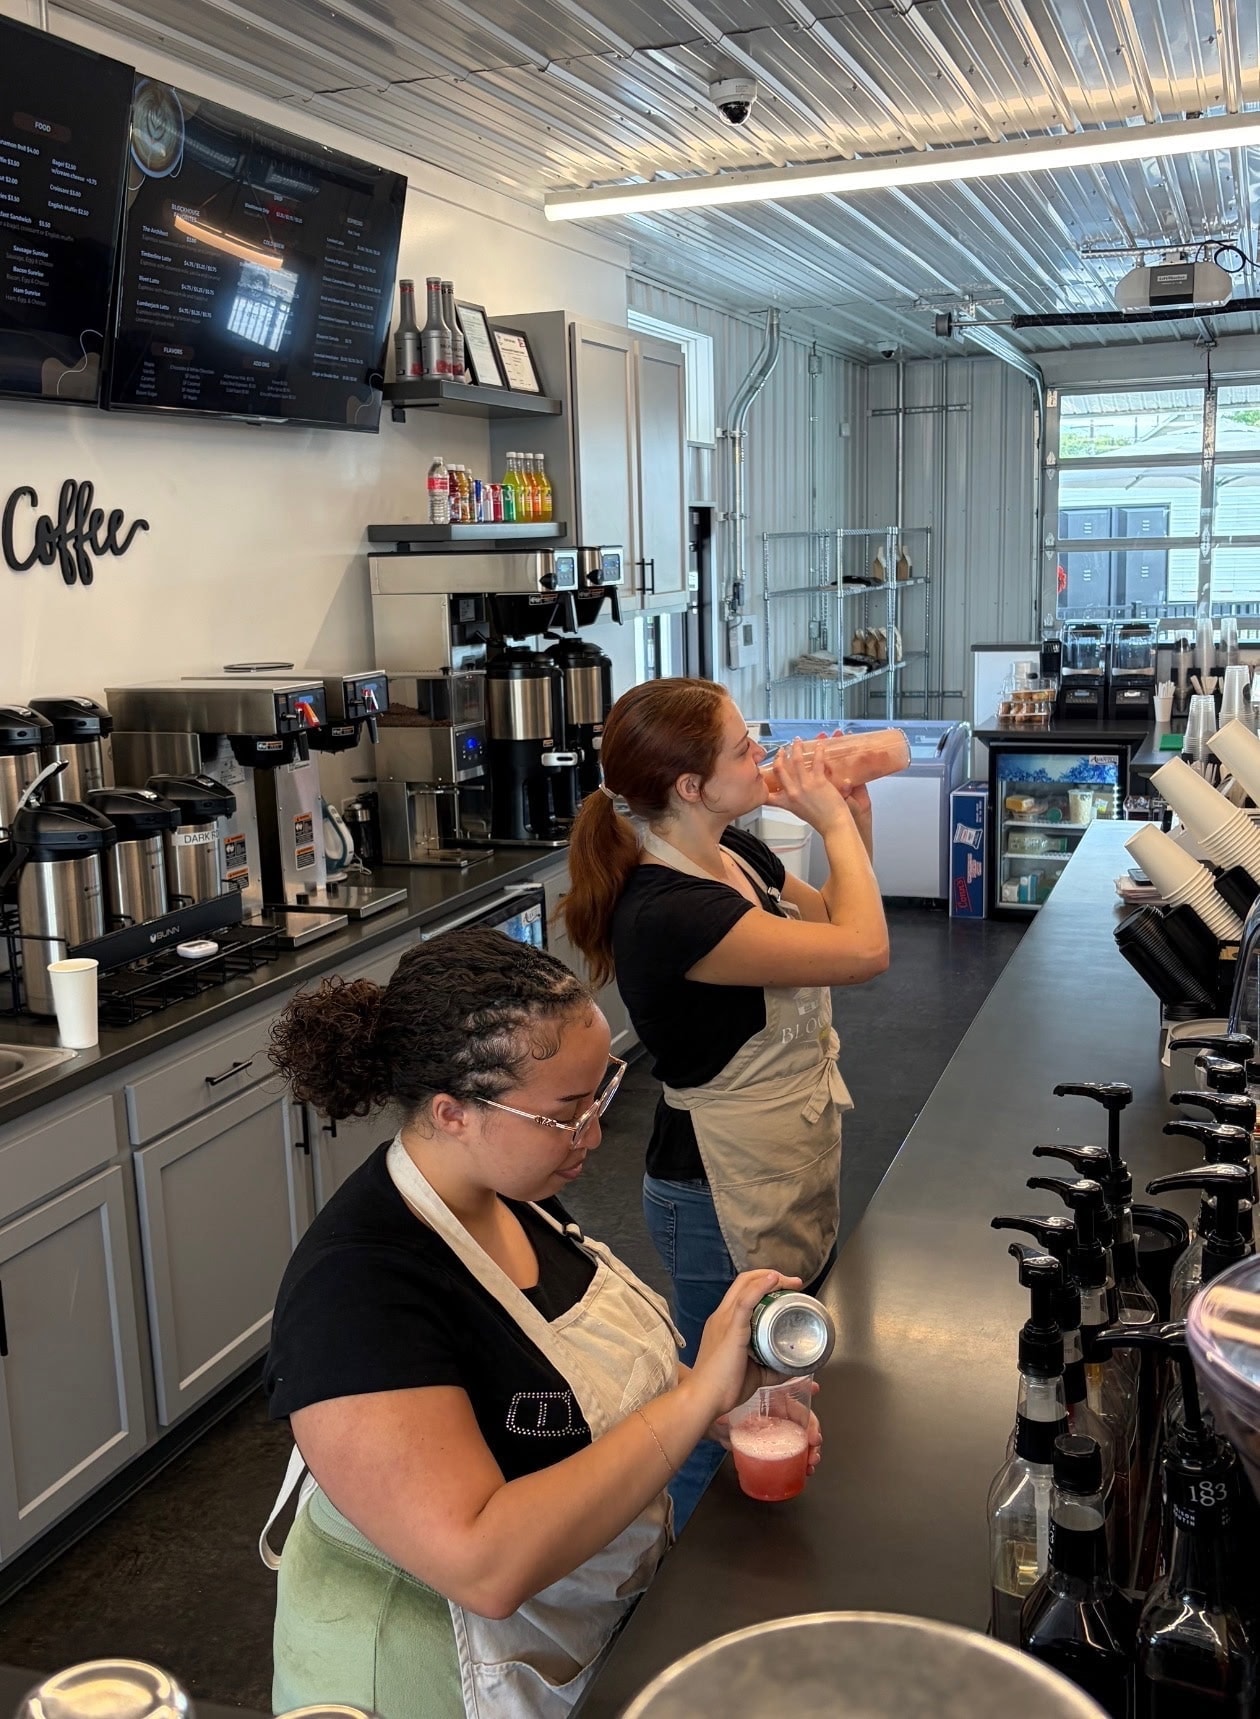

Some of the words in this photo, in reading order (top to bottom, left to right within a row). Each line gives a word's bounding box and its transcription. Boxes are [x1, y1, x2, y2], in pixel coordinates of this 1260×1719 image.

[35, 121, 51, 132] FOOD
[171, 203, 200, 217] BLOCKHOUSE
[10, 213, 32, 224] Sandwich
[163, 346, 183, 355] FLAVORS
[2, 478, 150, 586] Coffee
[184, 832, 210, 844] DARK
[157, 925, 180, 940] BUNN
